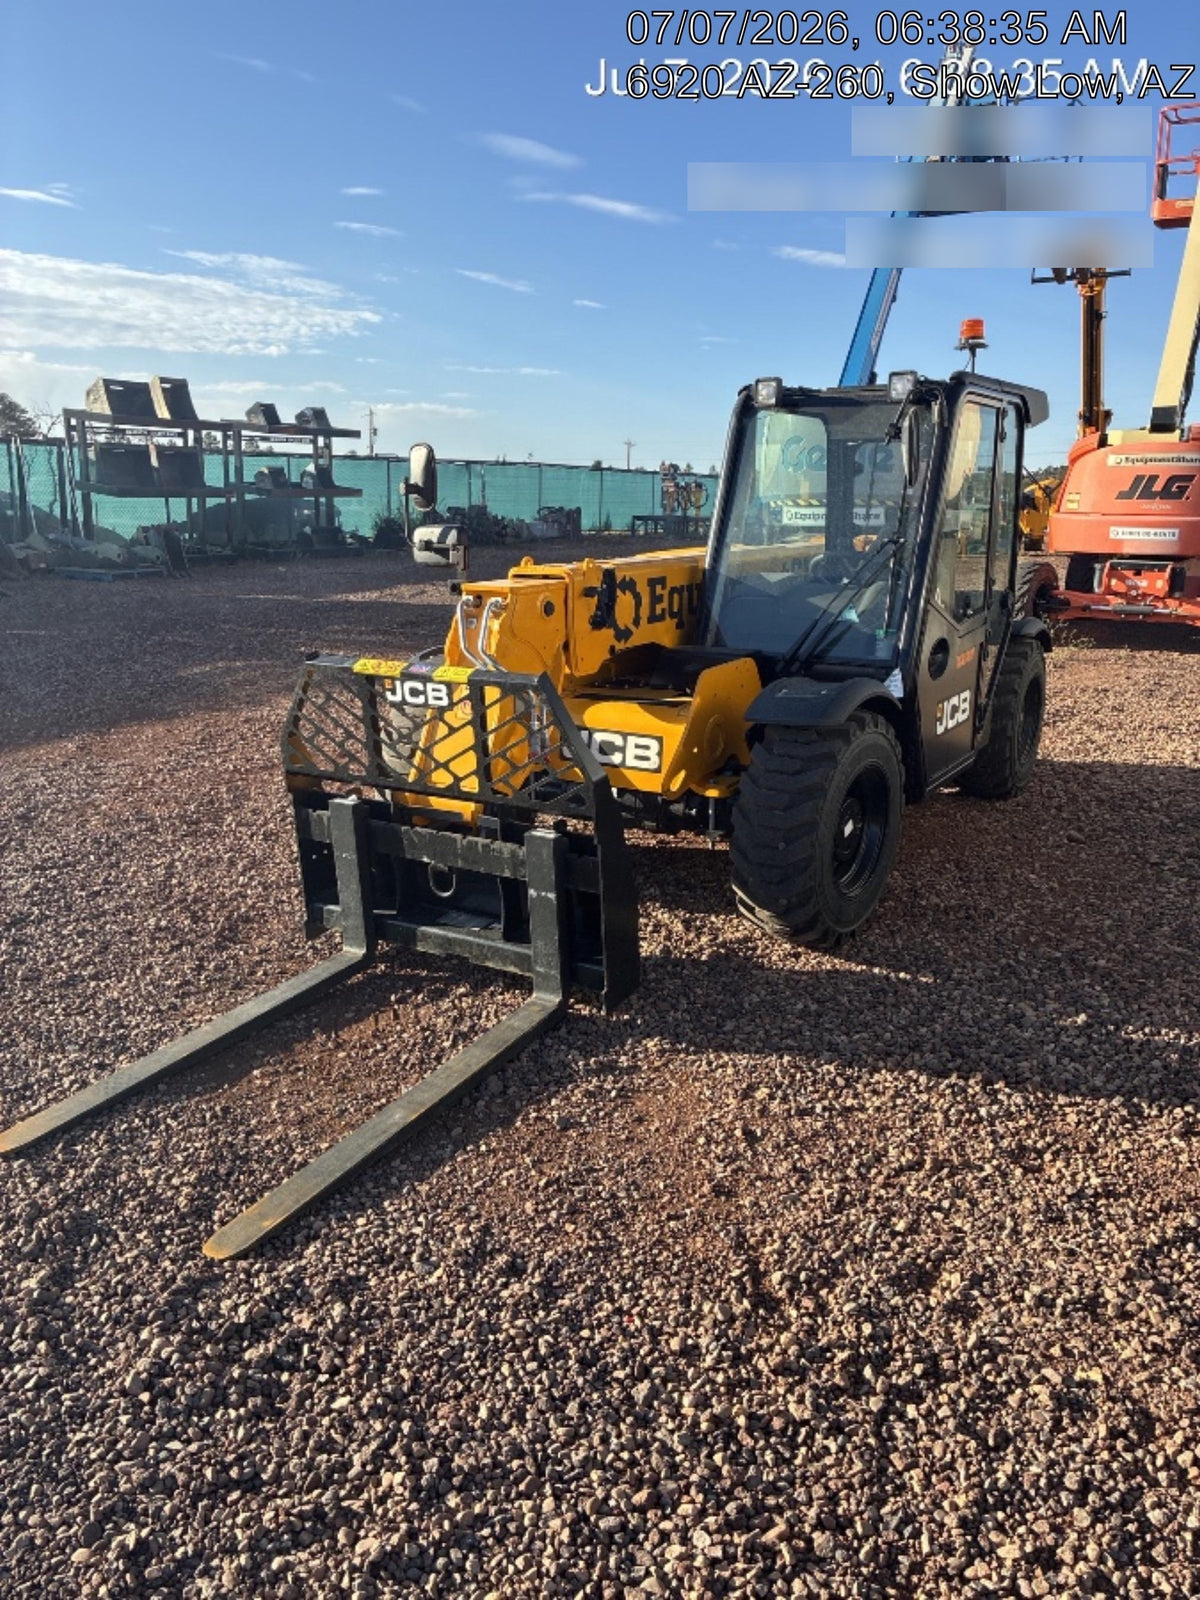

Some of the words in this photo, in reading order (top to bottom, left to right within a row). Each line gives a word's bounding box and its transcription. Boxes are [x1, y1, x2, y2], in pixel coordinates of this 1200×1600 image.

[1115, 473, 1197, 501] JLG
[385, 679, 449, 706] JCB
[936, 689, 971, 735] JCB
